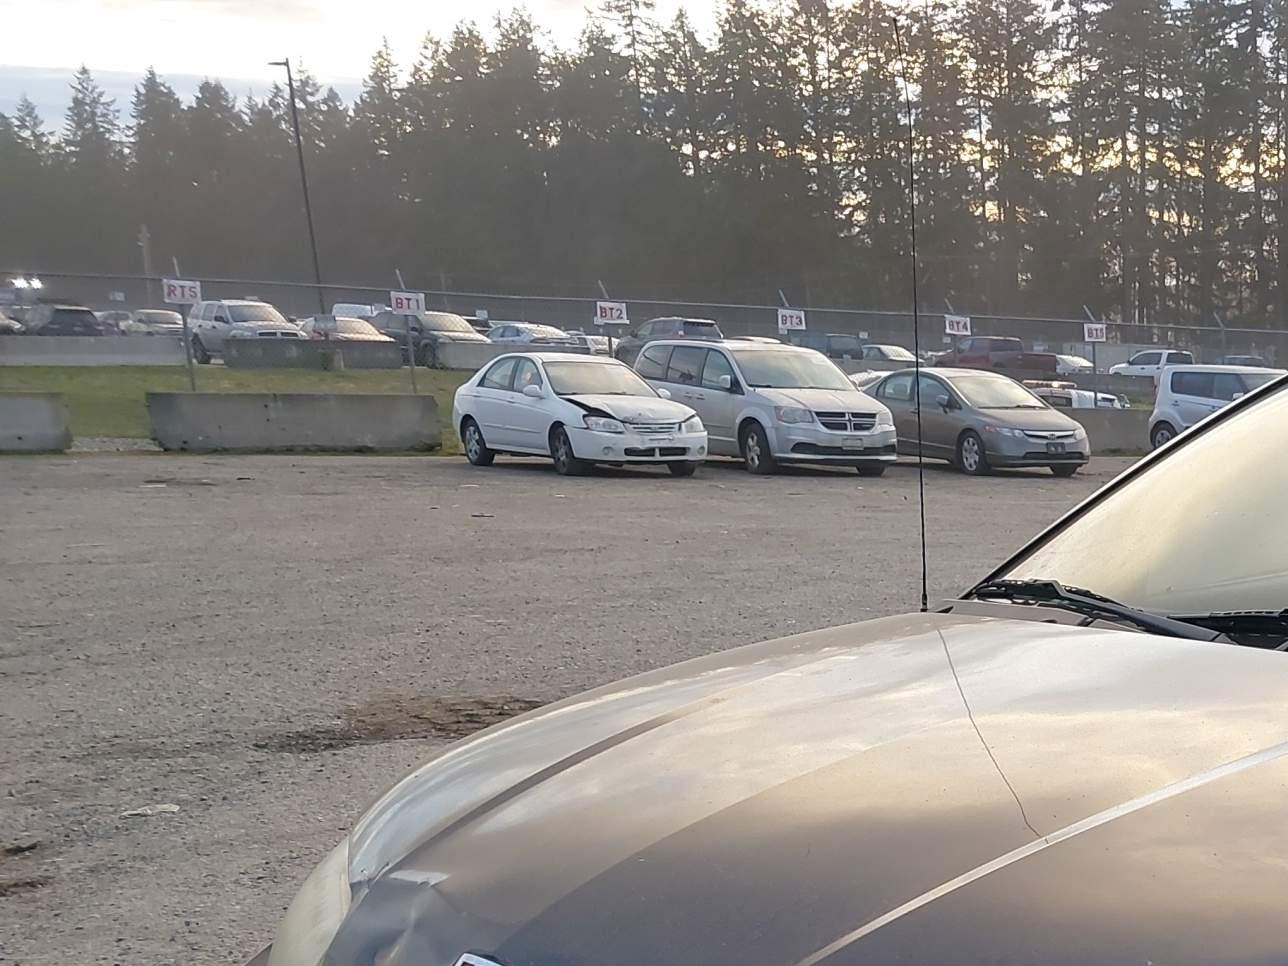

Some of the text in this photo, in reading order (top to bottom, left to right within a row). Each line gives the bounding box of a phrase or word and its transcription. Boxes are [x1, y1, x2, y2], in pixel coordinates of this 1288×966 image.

[395, 297, 421, 311] BT1
[599, 305, 624, 320] BT2
[780, 314, 802, 326] BT3
[948, 320, 969, 332] BT4
